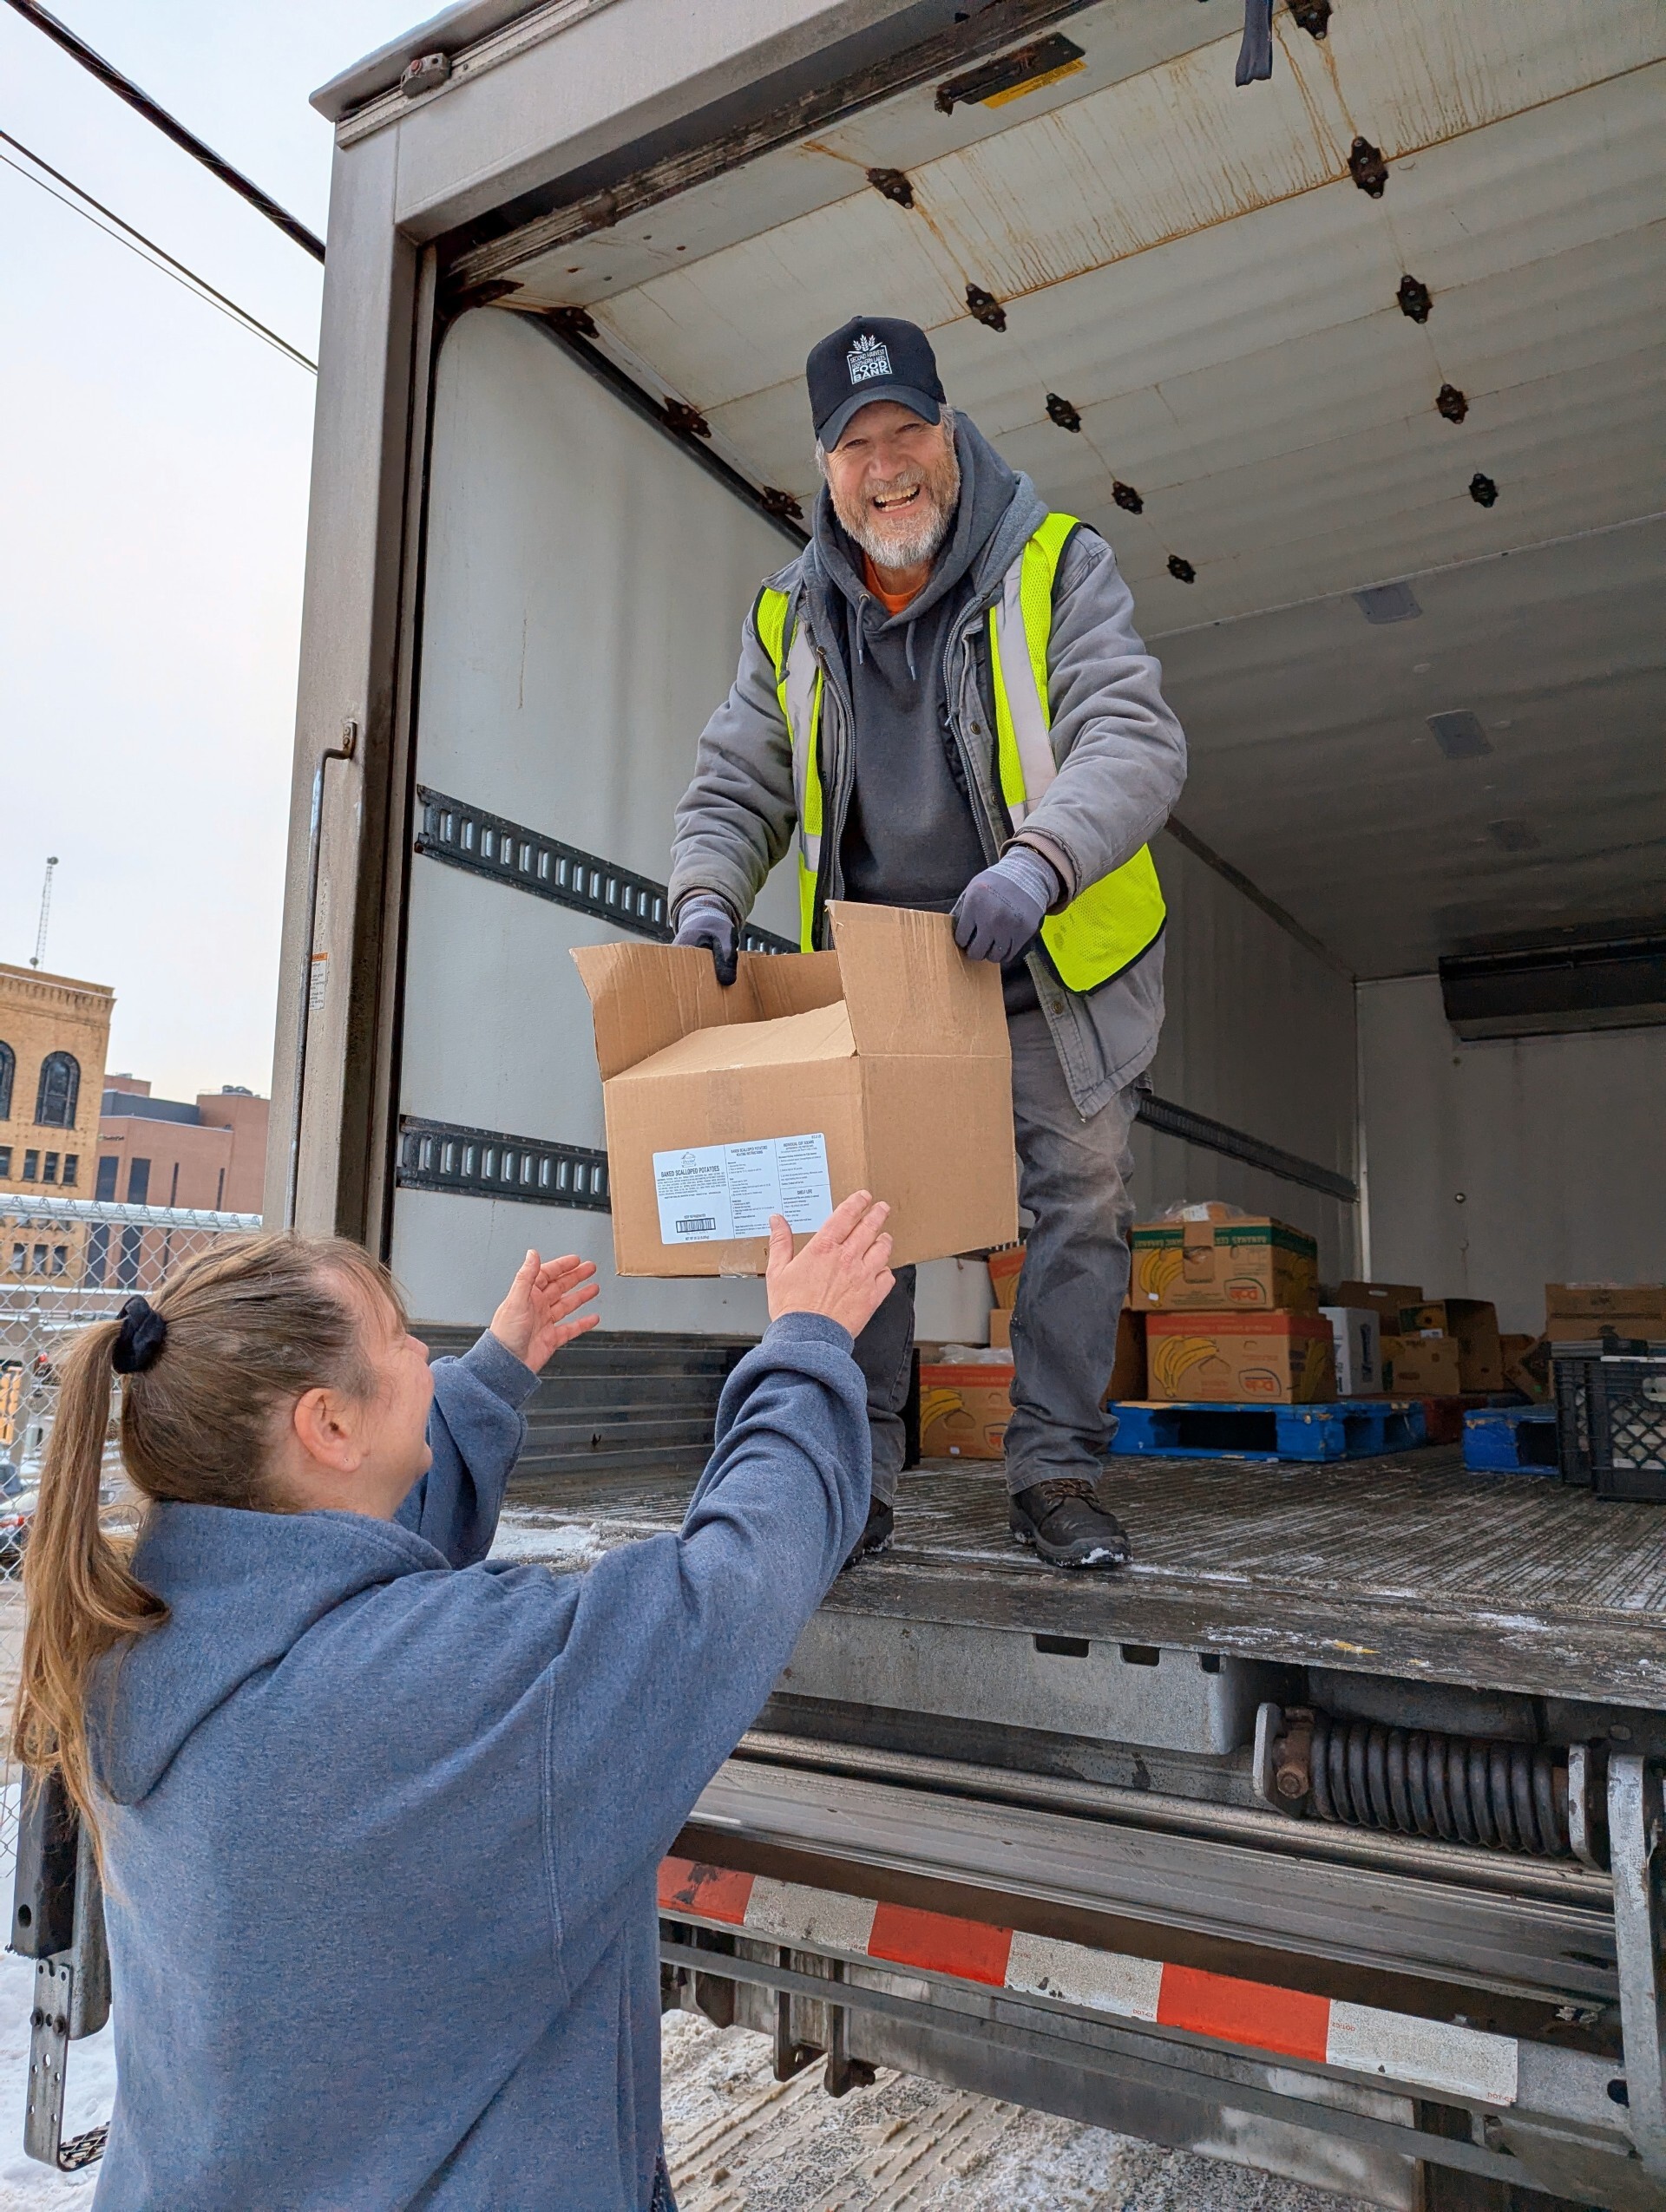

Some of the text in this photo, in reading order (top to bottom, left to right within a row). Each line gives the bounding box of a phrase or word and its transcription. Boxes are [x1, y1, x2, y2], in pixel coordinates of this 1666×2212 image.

[867, 349, 885, 357] HARVEST
[852, 360, 887, 376] FOOD
[854, 366, 889, 383] BANK
[675, 1168, 699, 1176] SCALLOPED
[1230, 1289, 1258, 1300] Dole
[1243, 1379, 1274, 1392] Dole
[1132, 2008, 1154, 2019] DOT-C2
[1331, 2022, 1355, 2032] DOT-C2
[1487, 2091, 1513, 2103] DOT-C2
